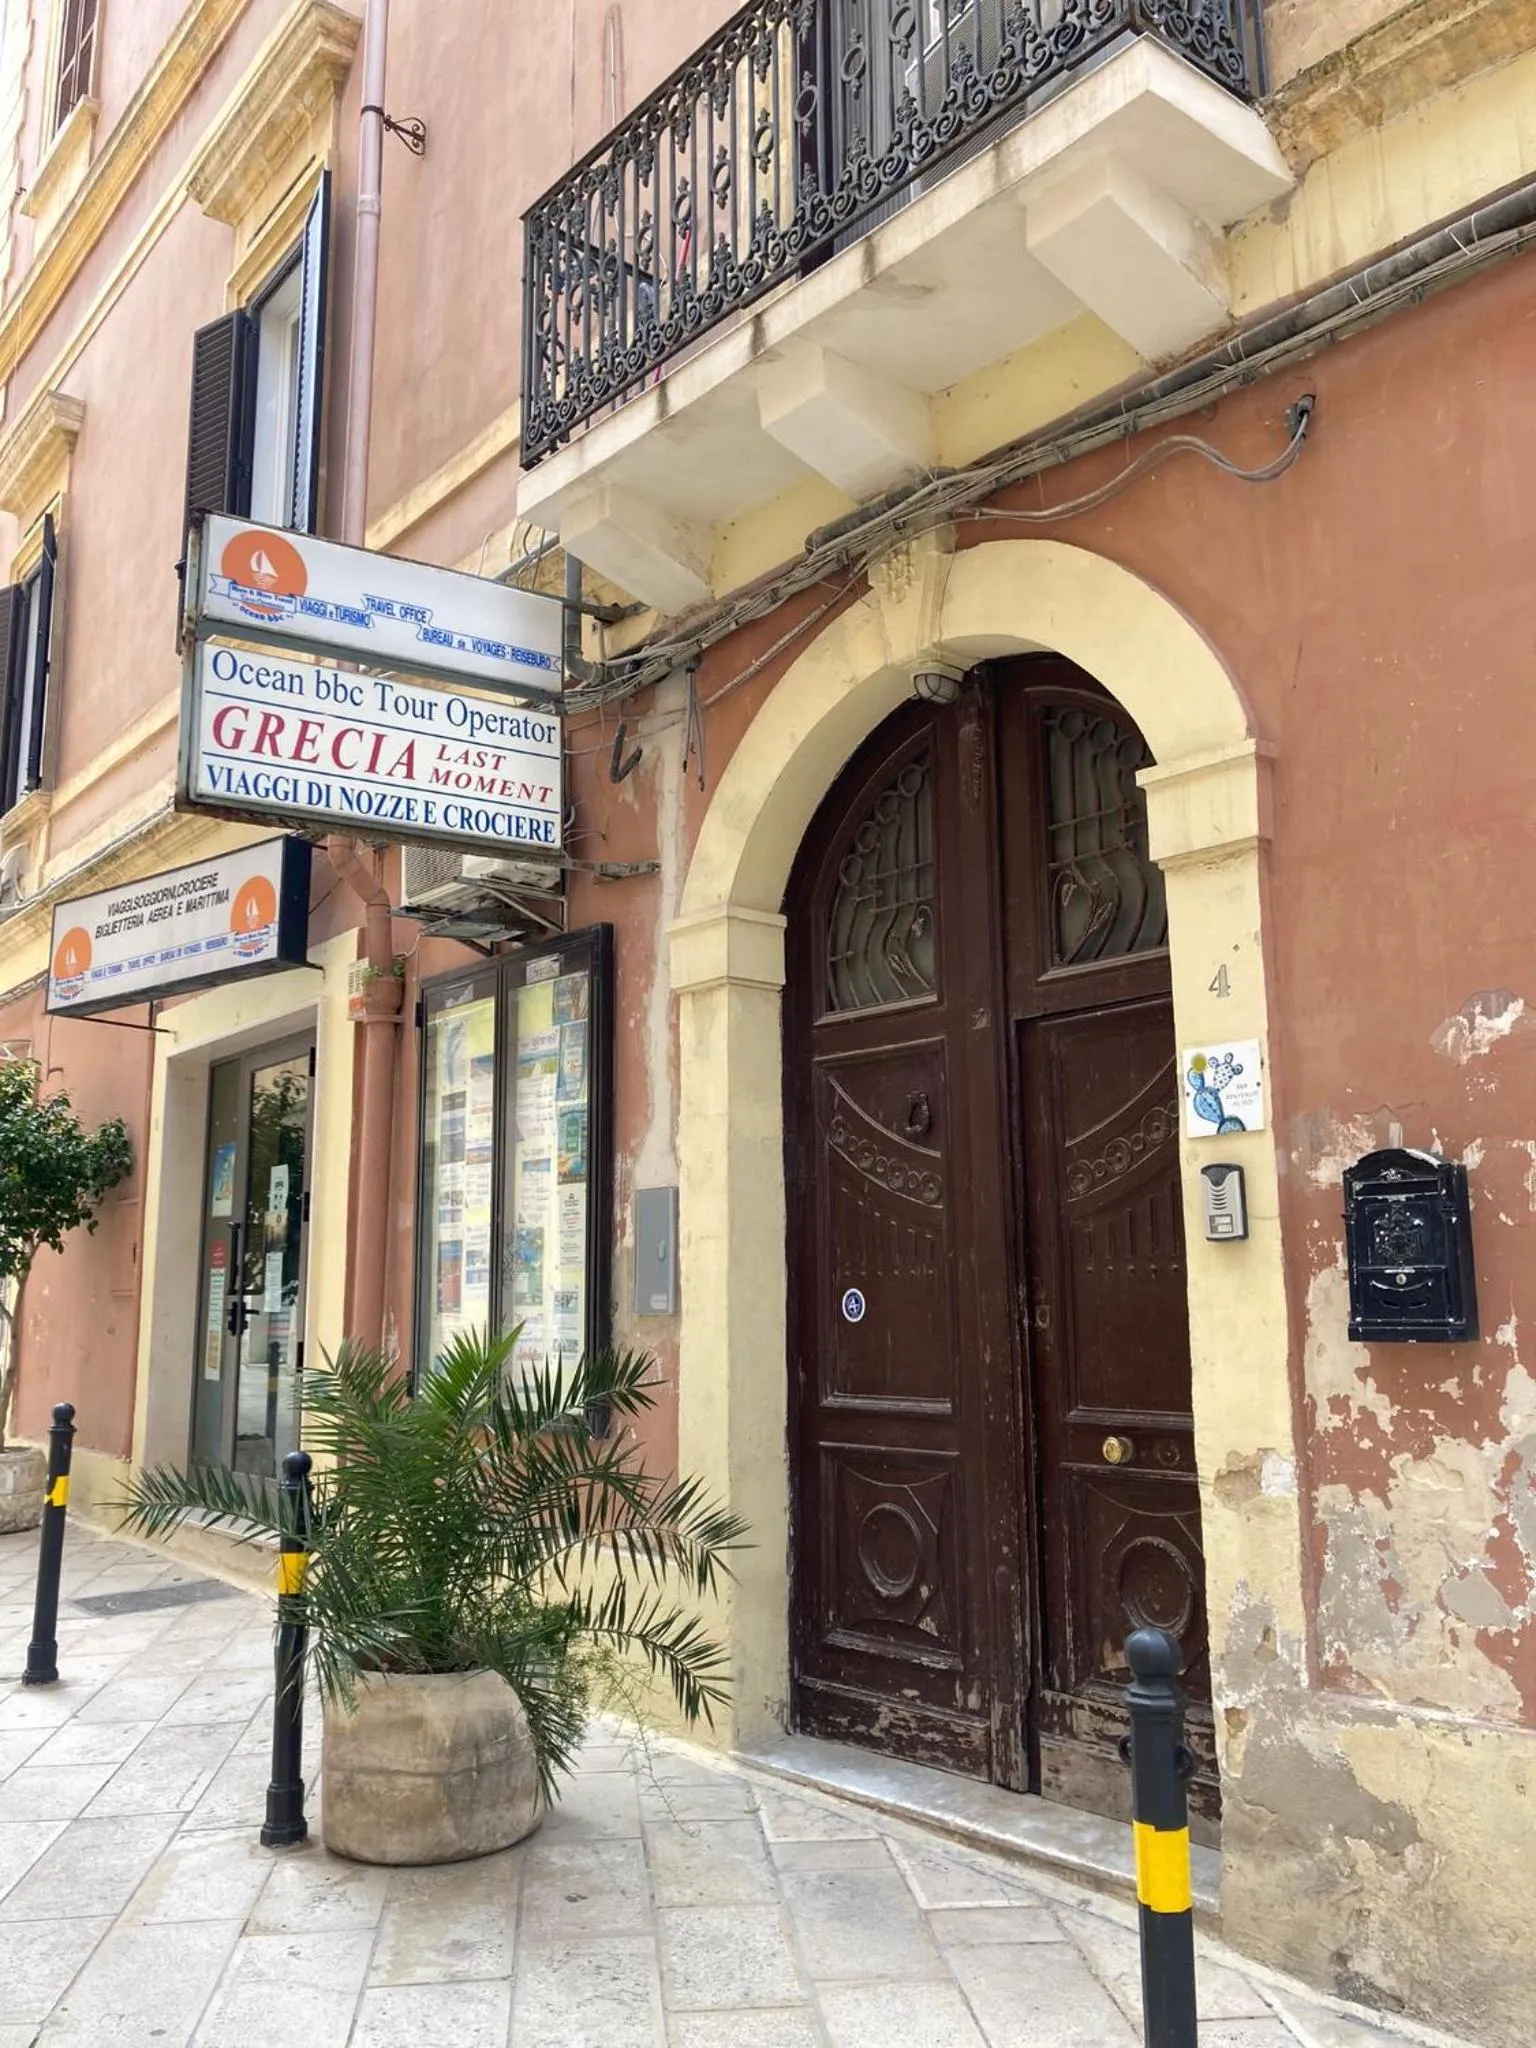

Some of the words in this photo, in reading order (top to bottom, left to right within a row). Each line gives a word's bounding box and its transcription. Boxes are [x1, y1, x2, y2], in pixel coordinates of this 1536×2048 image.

[300, 598, 327, 616] VIAGGI
[335, 605, 371, 626] TURISMO
[366, 597, 396, 616] TRAVEL
[399, 605, 427, 624] OFFICE
[422, 629, 454, 648] BUREAU
[471, 639, 506, 658] VOYAGES
[212, 650, 304, 696] Ocean
[315, 669, 364, 707] bbc
[374, 682, 438, 721] Tour
[446, 698, 556, 744] Operator
[212, 705, 416, 780] GRECIA
[436, 743, 507, 771] LAST
[429, 767, 553, 804] MOMENT
[206, 764, 300, 803] VIAGGI
[307, 781, 332, 809] DI
[339, 786, 418, 823] NOZZE
[423, 801, 437, 824] E
[443, 803, 556, 844] CROCIERE
[95, 912, 144, 939] BIGLIETTERIA
[147, 904, 173, 924] AEREA
[176, 901, 184, 916] E
[185, 888, 230, 913] MARITTIMA
[1208, 963, 1231, 998] 4
